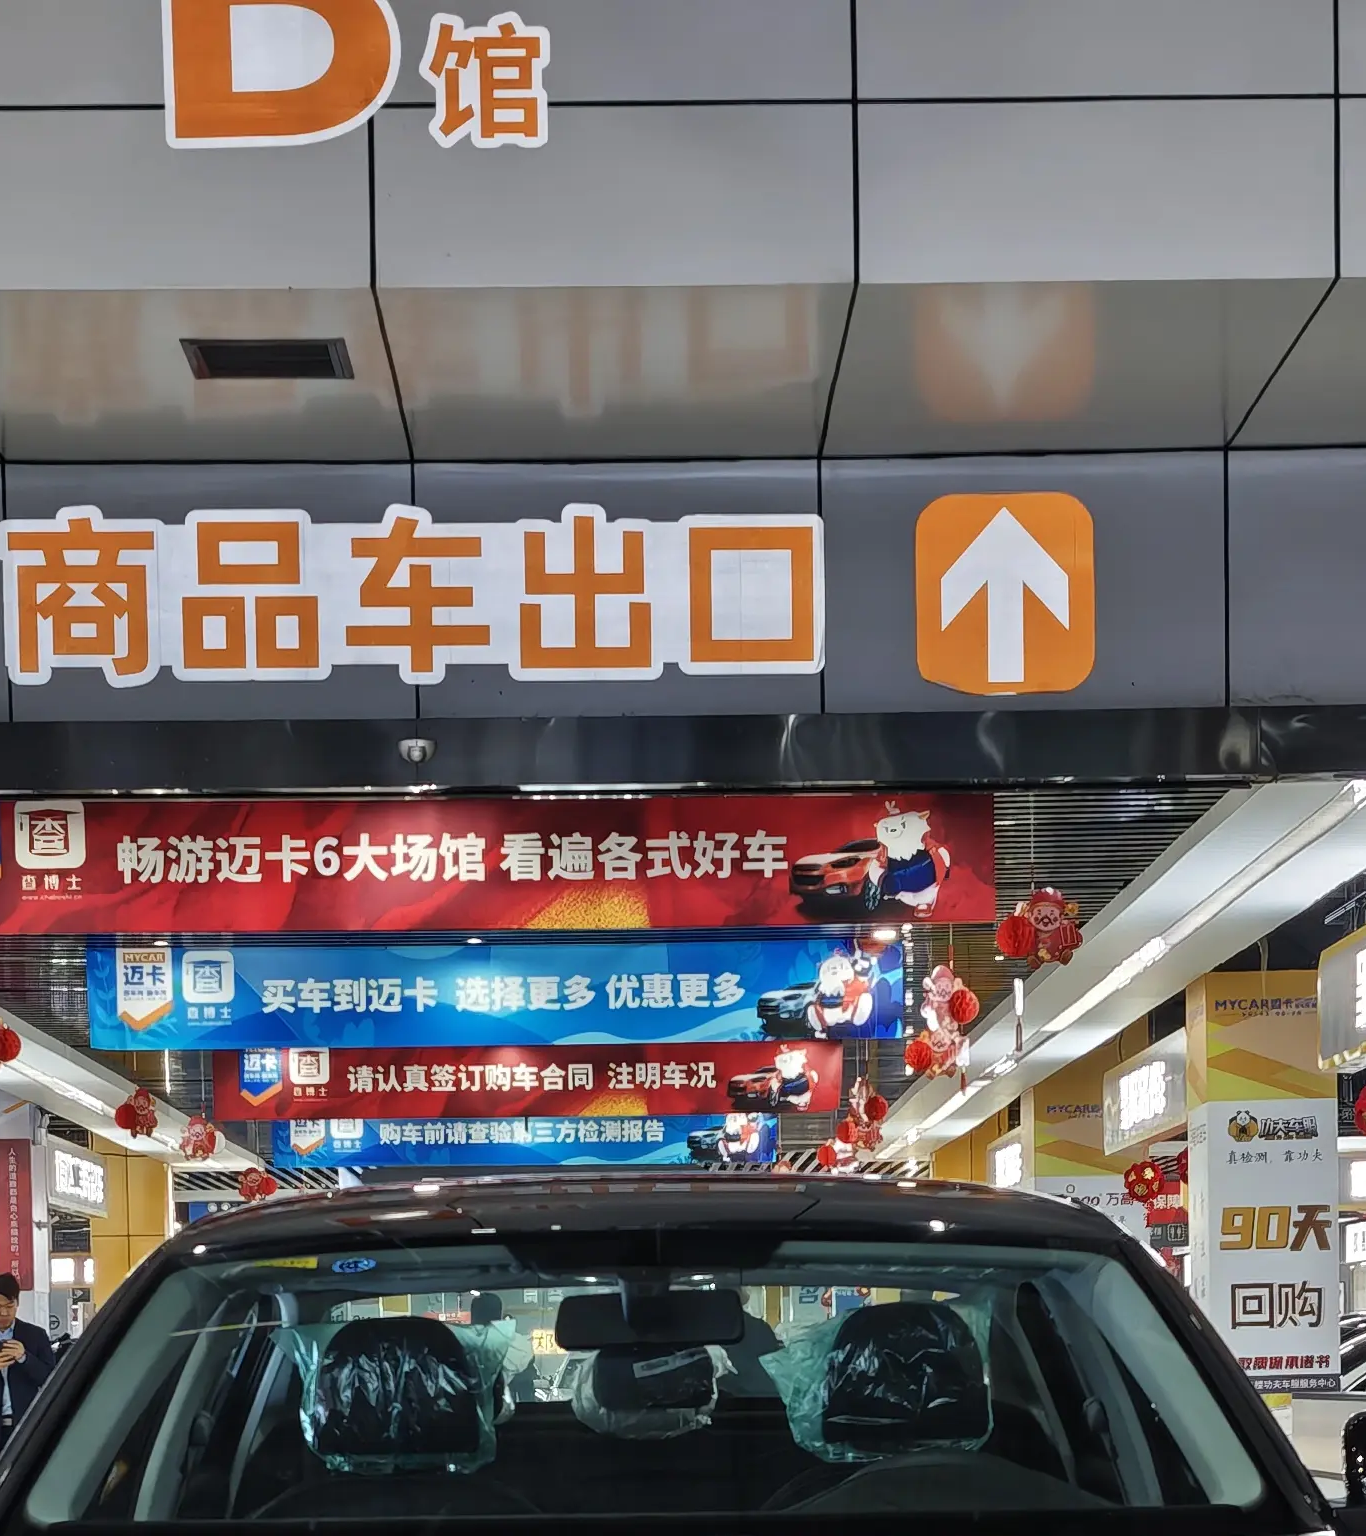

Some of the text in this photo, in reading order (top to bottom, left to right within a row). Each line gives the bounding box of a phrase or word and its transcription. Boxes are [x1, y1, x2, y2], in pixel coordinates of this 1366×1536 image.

[1, 506, 821, 686] 商品车出口
[117, 829, 788, 884] 畅游迈卡6大场馆 看遍各式好车
[21, 873, 83, 891] 查博士
[123, 953, 164, 963] MYCAR
[123, 965, 166, 986] 迈卡
[261, 970, 746, 1014] 买车到迈卡 选择更多 优惠更多
[347, 1060, 717, 1094] 请认真签订购车合同 注明车况
[379, 1119, 665, 1146] 购车前请查验第三方检测报告
[1220, 1204, 1333, 1252] 90天
[1231, 1280, 1325, 1330] 回购
